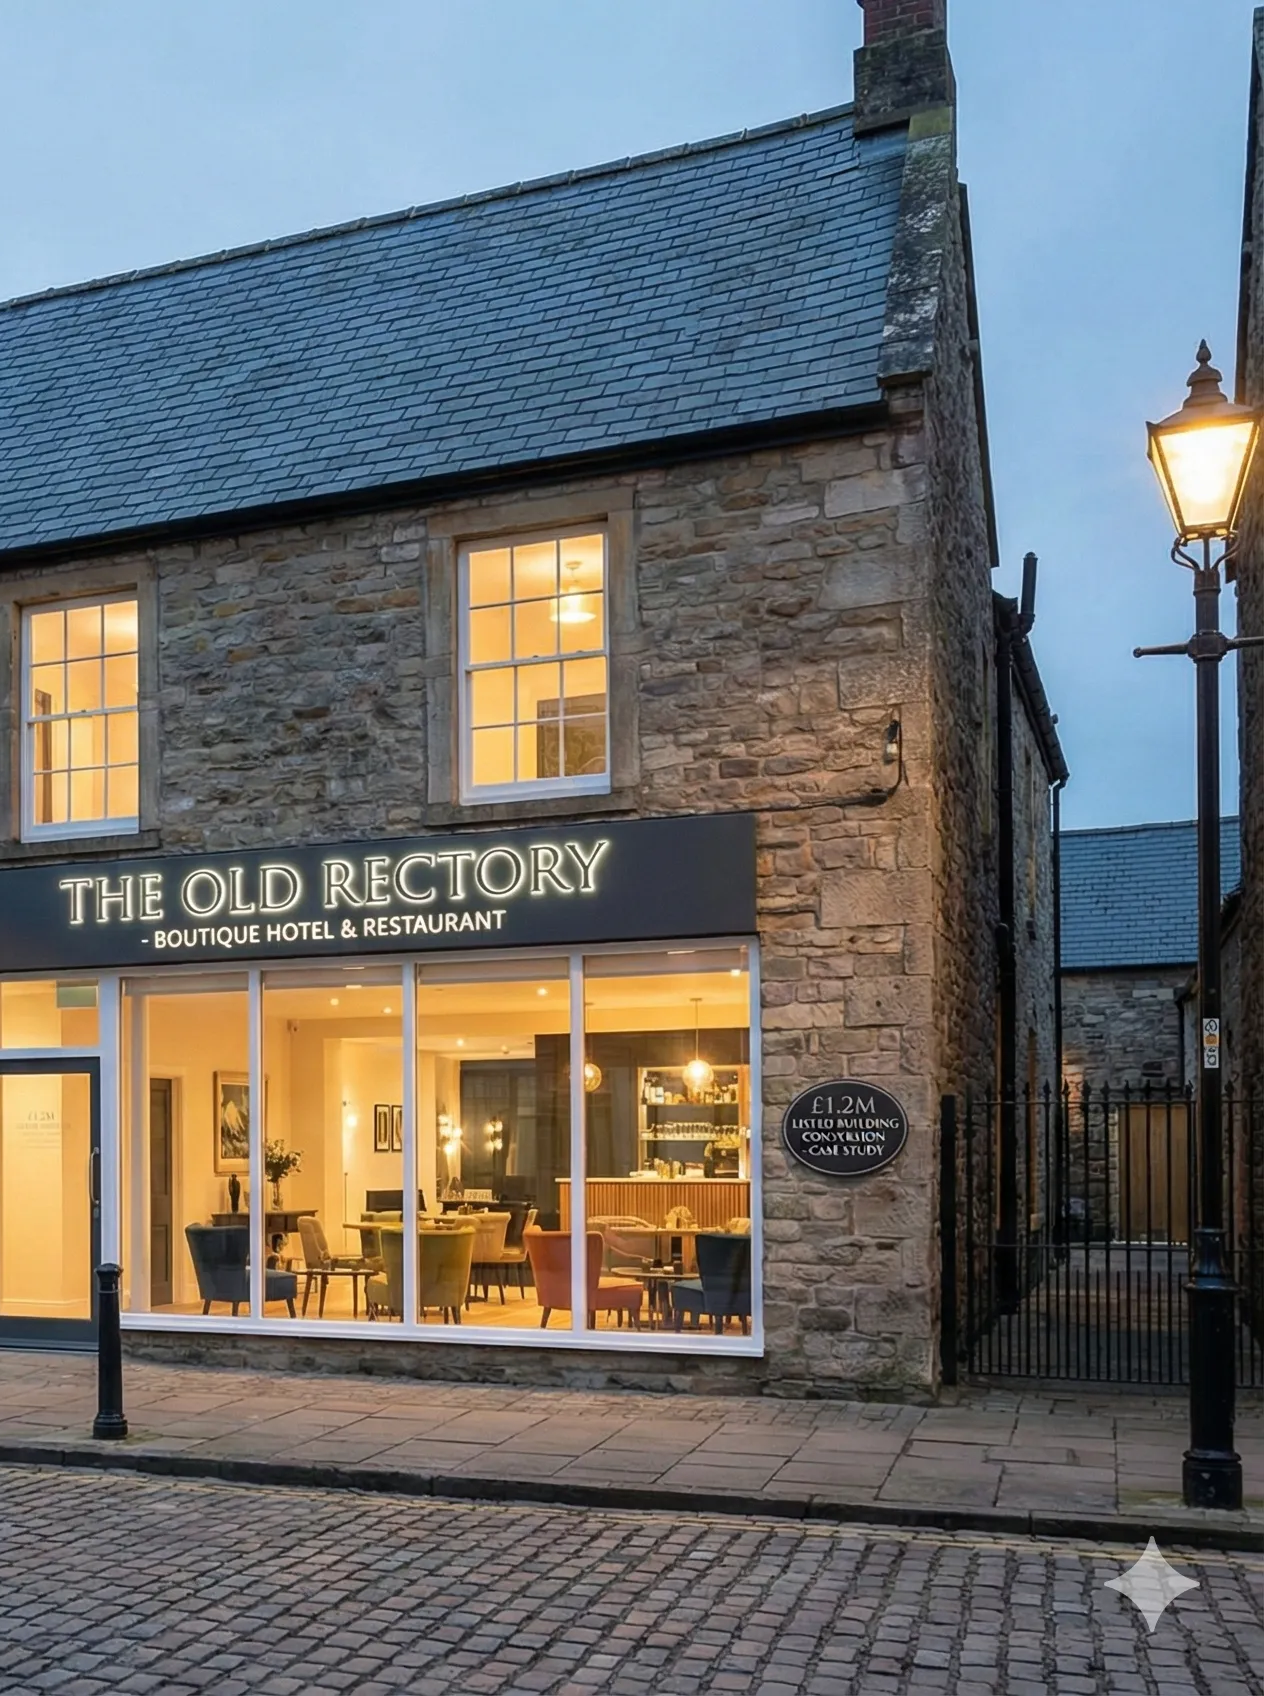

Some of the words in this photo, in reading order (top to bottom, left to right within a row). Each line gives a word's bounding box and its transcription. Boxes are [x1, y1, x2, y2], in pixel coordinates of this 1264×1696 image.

[59, 874, 164, 924] THE
[181, 863, 300, 917] OLD
[322, 840, 609, 908] RECTORY
[154, 924, 261, 949] BOUTIQUE
[267, 920, 334, 942] HOTEL
[341, 918, 357, 938] &
[363, 909, 507, 937] RESTAURANT
[811, 1096, 876, 1114] £1.2M
[843, 1145, 884, 1156] STUDY
